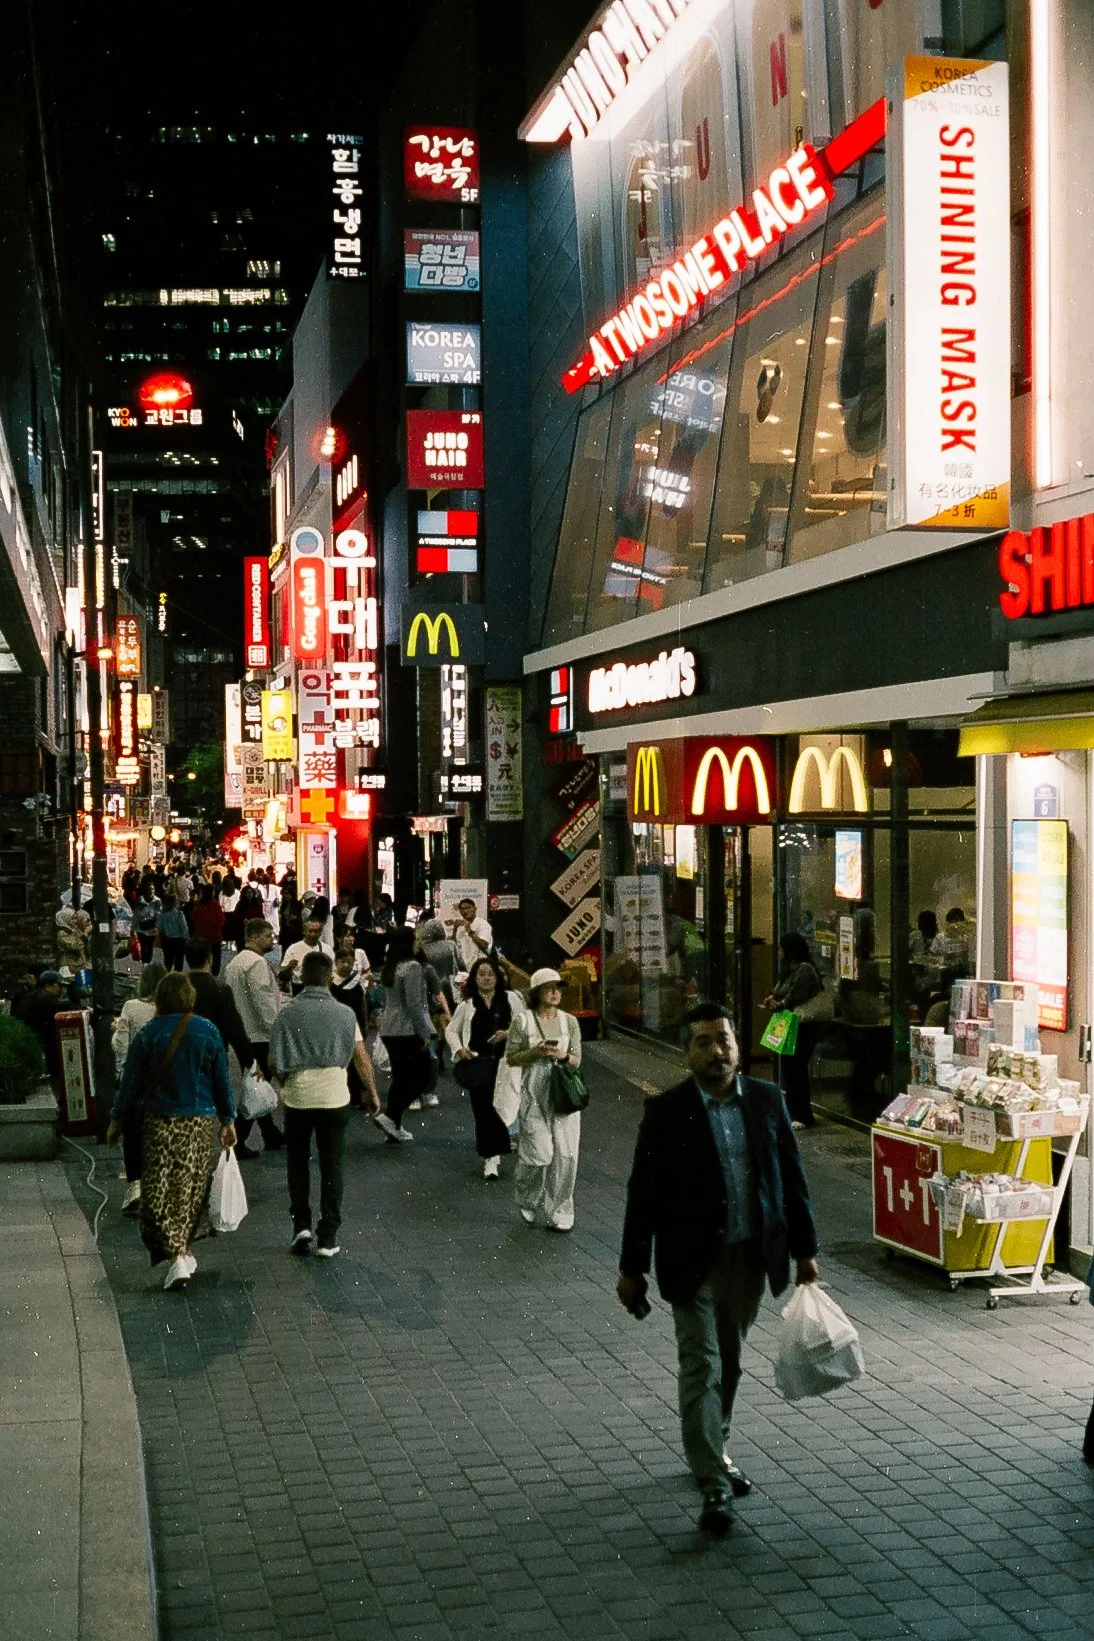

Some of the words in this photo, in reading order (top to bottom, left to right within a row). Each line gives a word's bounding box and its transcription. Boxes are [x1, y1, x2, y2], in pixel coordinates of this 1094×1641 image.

[934, 66, 978, 82] KOREA
[920, 80, 992, 98] COSMETICS
[973, 104, 1001, 118] SALE
[415, 158, 472, 189] 면옥
[461, 187, 479, 202] 5F
[331, 148, 362, 263] 함흥냉면
[713, 150, 827, 272] PLACE
[939, 124, 977, 306] SHINING
[420, 243, 467, 265] 청년
[329, 266, 358, 278] 우대포
[419, 265, 468, 286] 다방
[412, 330, 476, 348] KOREA
[443, 351, 476, 368] SPA
[463, 370, 480, 384] 4F
[940, 327, 977, 453] MASK
[107, 408, 130, 417] KYO
[111, 417, 138, 427] WON
[144, 408, 203, 426] 교원그룹
[423, 431, 469, 449] JUNO
[425, 449, 467, 467] HAIR
[919, 483, 998, 501] 有名化妆品
[251, 563, 261, 585] RED
[251, 585, 262, 643] CONTAINER
[588, 647, 697, 713] McDonald's
[331, 717, 380, 749] 블랙
[304, 751, 337, 782] 藥
[558, 867, 587, 896] KOREA
[566, 911, 595, 945] JUNO
[883, 1166, 930, 1226] 1+1
